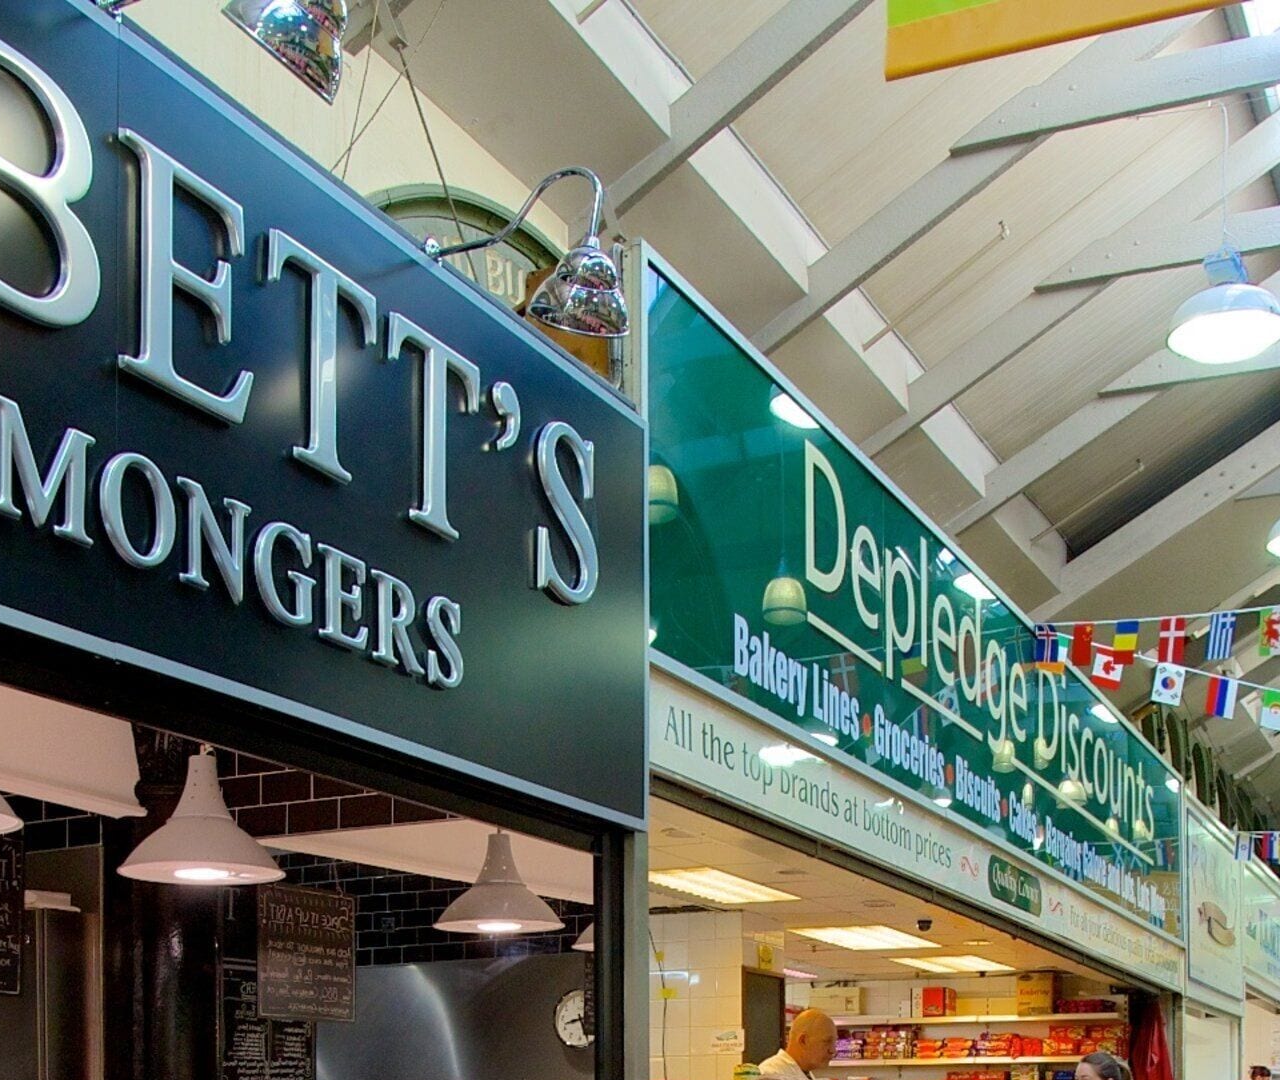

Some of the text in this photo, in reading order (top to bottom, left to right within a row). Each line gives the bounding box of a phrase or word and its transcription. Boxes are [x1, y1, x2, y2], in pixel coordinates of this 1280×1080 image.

[803, 438, 1027, 751] Depledge
[663, 704, 952, 869] All the top brands at bottom prices
[733, 612, 809, 717] Bakery
[813, 666, 861, 741] Lines
[873, 703, 945, 789] Groceries
[955, 753, 1001, 824] Biscuits
[1008, 790, 1038, 844] Cakes
[1037, 666, 1154, 841] Discounts
[992, 862, 1018, 903] Quality
